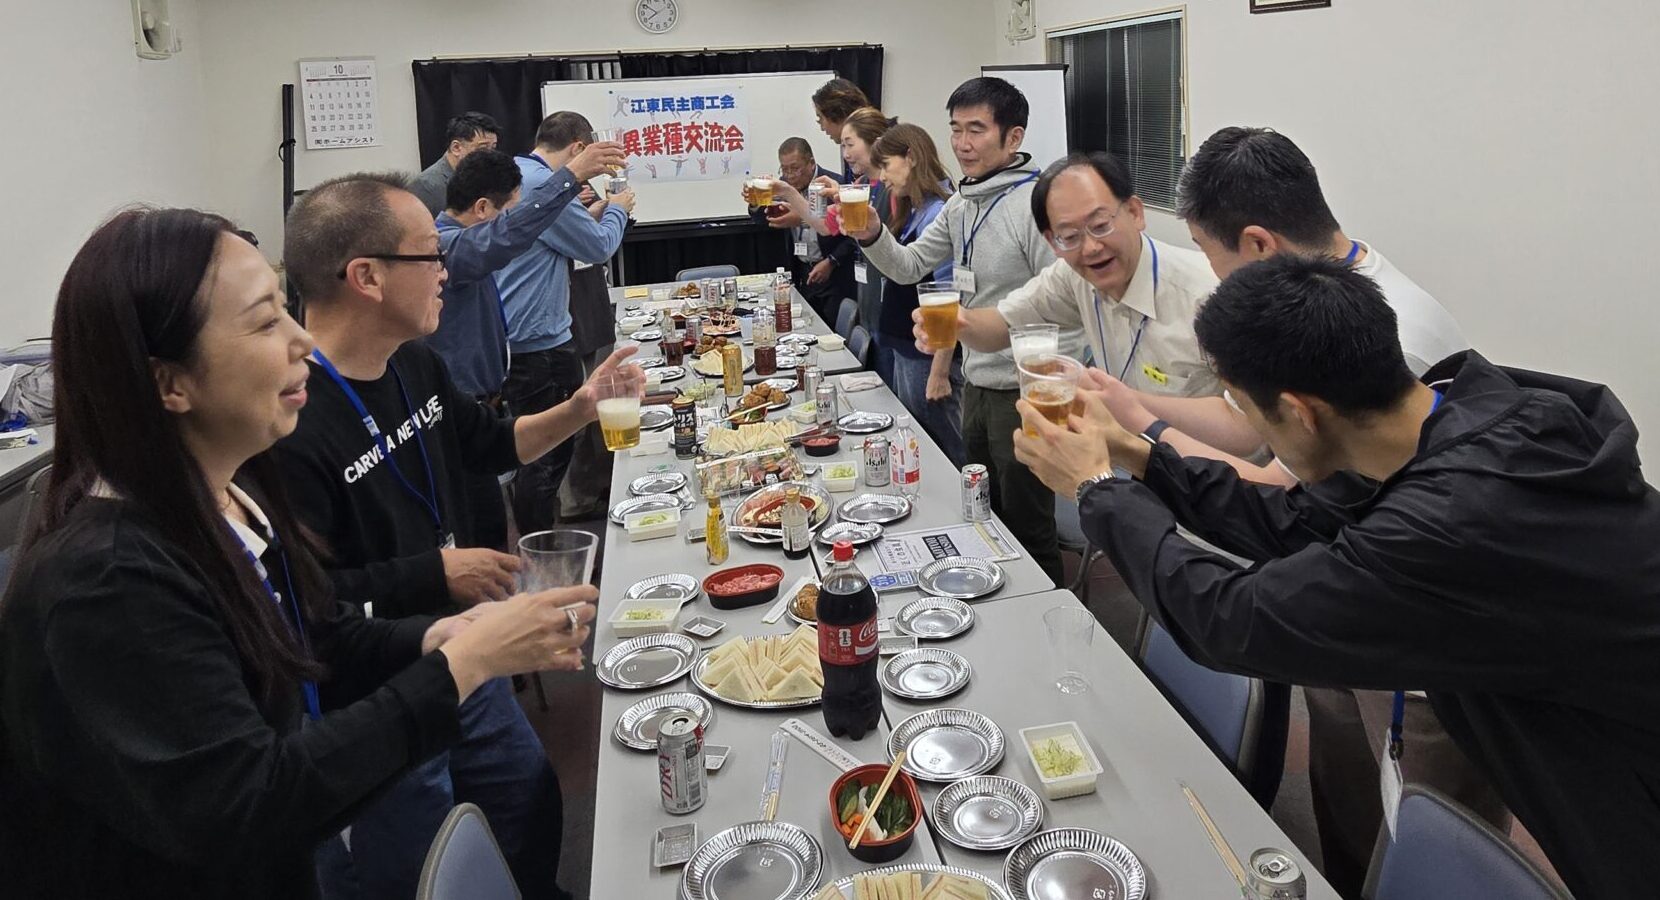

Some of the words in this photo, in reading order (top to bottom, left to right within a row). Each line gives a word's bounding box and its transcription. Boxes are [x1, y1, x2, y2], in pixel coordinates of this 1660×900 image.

[334, 65, 343, 74] 10
[631, 95, 735, 113] 江東民主商工会
[623, 121, 744, 157] 異業種交流会
[386, 434, 396, 453] A
[866, 457, 887, 467] Asahi
[660, 753, 673, 801] DRY
